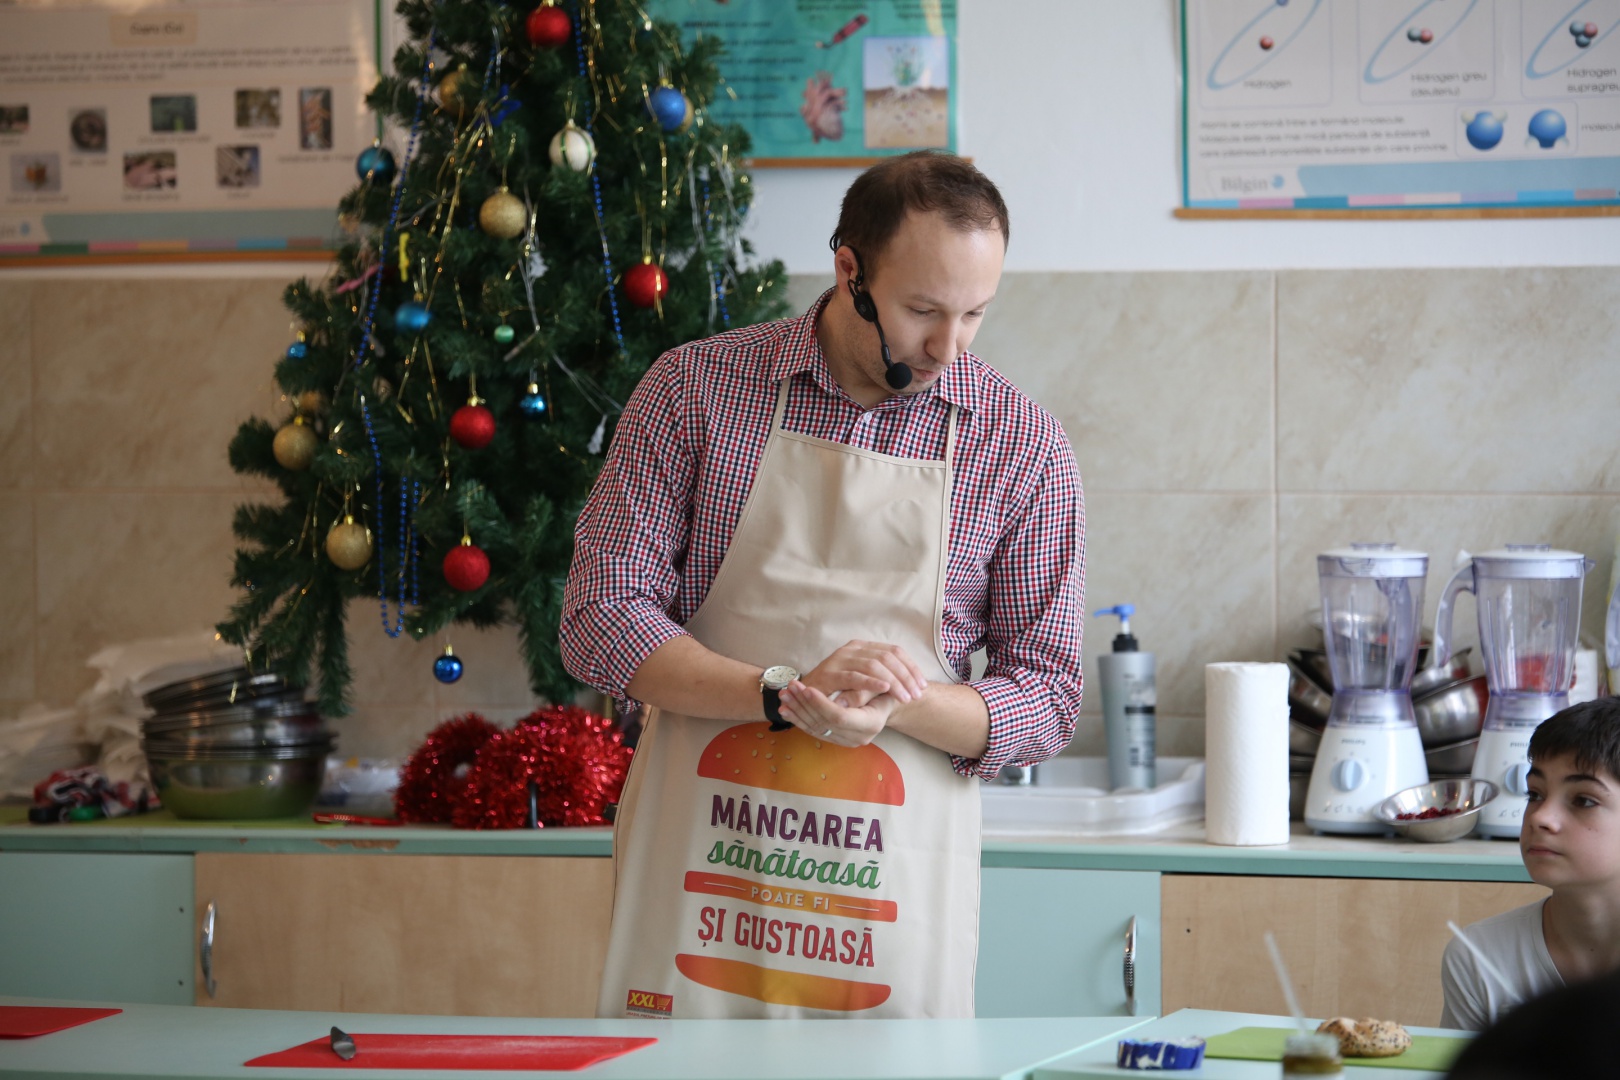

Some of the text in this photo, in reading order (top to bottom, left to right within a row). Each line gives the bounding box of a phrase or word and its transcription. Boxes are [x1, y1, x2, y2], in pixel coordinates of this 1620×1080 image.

[1410, 72, 1460, 83] Hidrogen
[1567, 67, 1617, 79] Hidrogen
[711, 794, 885, 853] MÂNCAREA
[751, 886, 830, 911] POATE FI
[628, 992, 655, 1008] XXL
